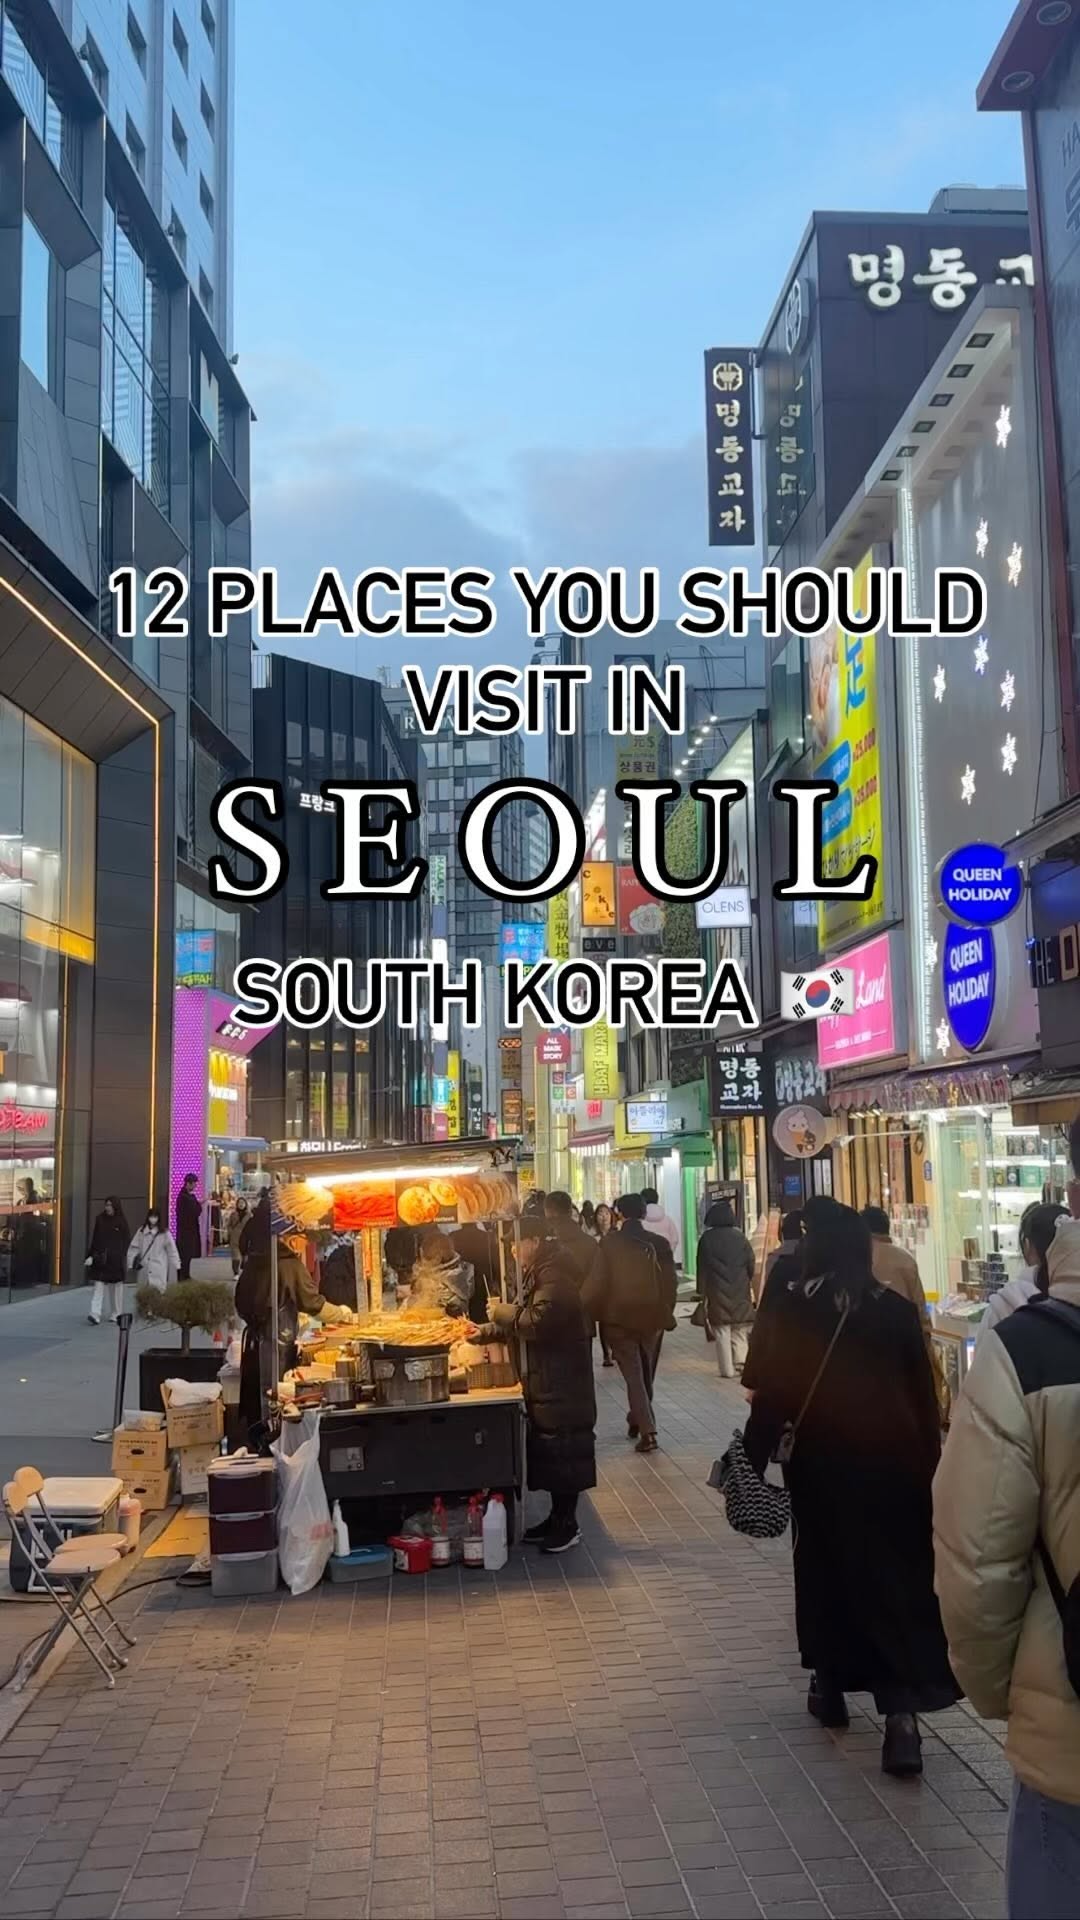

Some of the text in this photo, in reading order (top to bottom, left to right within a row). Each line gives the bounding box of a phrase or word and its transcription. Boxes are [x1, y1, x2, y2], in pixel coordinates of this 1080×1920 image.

[714, 401, 747, 533] 명동교자
[952, 867, 1003, 883] QUEEN
[948, 887, 1012, 902] HOLIDAY
[701, 900, 746, 914] OLENS
[949, 937, 983, 973] QUEEN
[948, 971, 991, 1008] HOLIDAY
[719, 1057, 761, 1079] 명동
[719, 1080, 762, 1101] 교자
